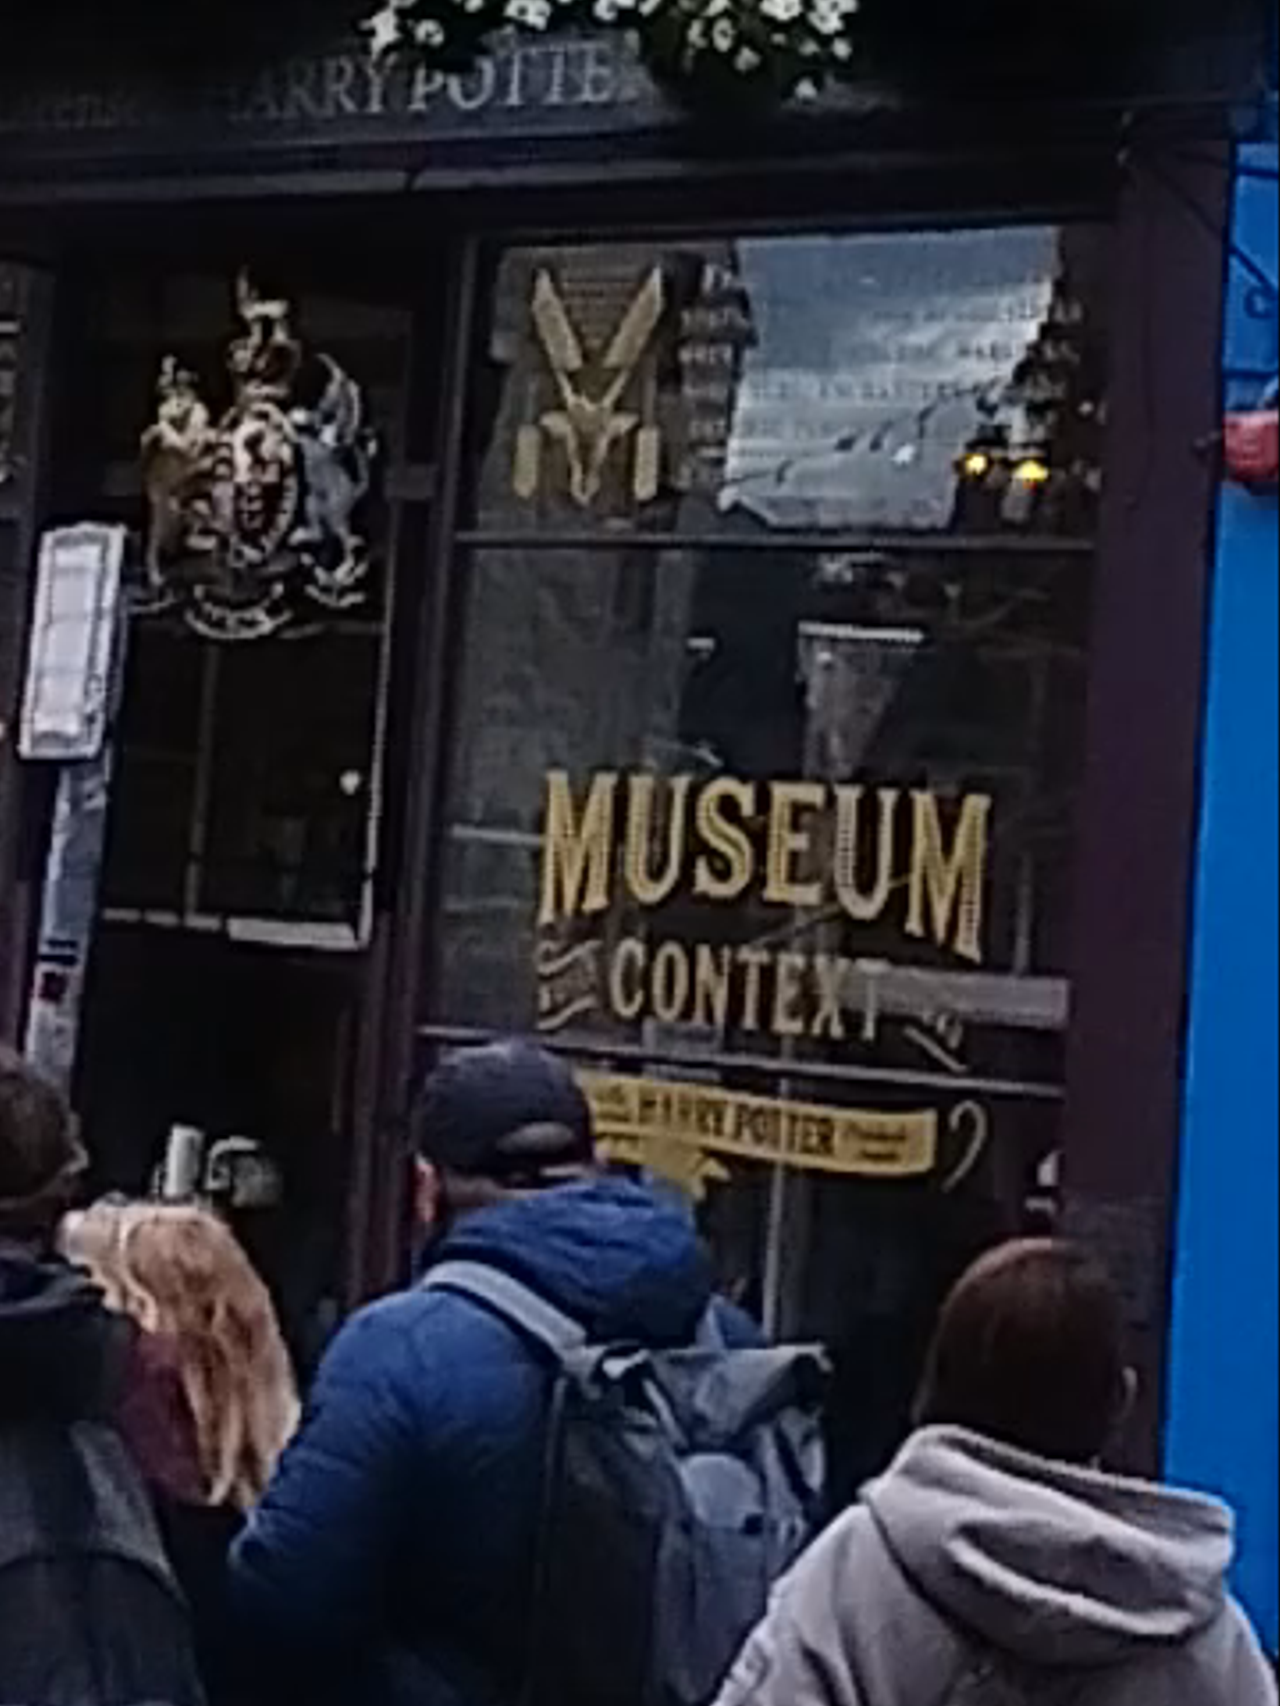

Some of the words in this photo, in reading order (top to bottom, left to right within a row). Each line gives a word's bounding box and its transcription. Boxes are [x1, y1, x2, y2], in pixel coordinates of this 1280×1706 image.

[540, 769, 992, 964] MUSEUM
[608, 937, 880, 1043] CONTEXT
[734, 1100, 836, 1156] POTTER
